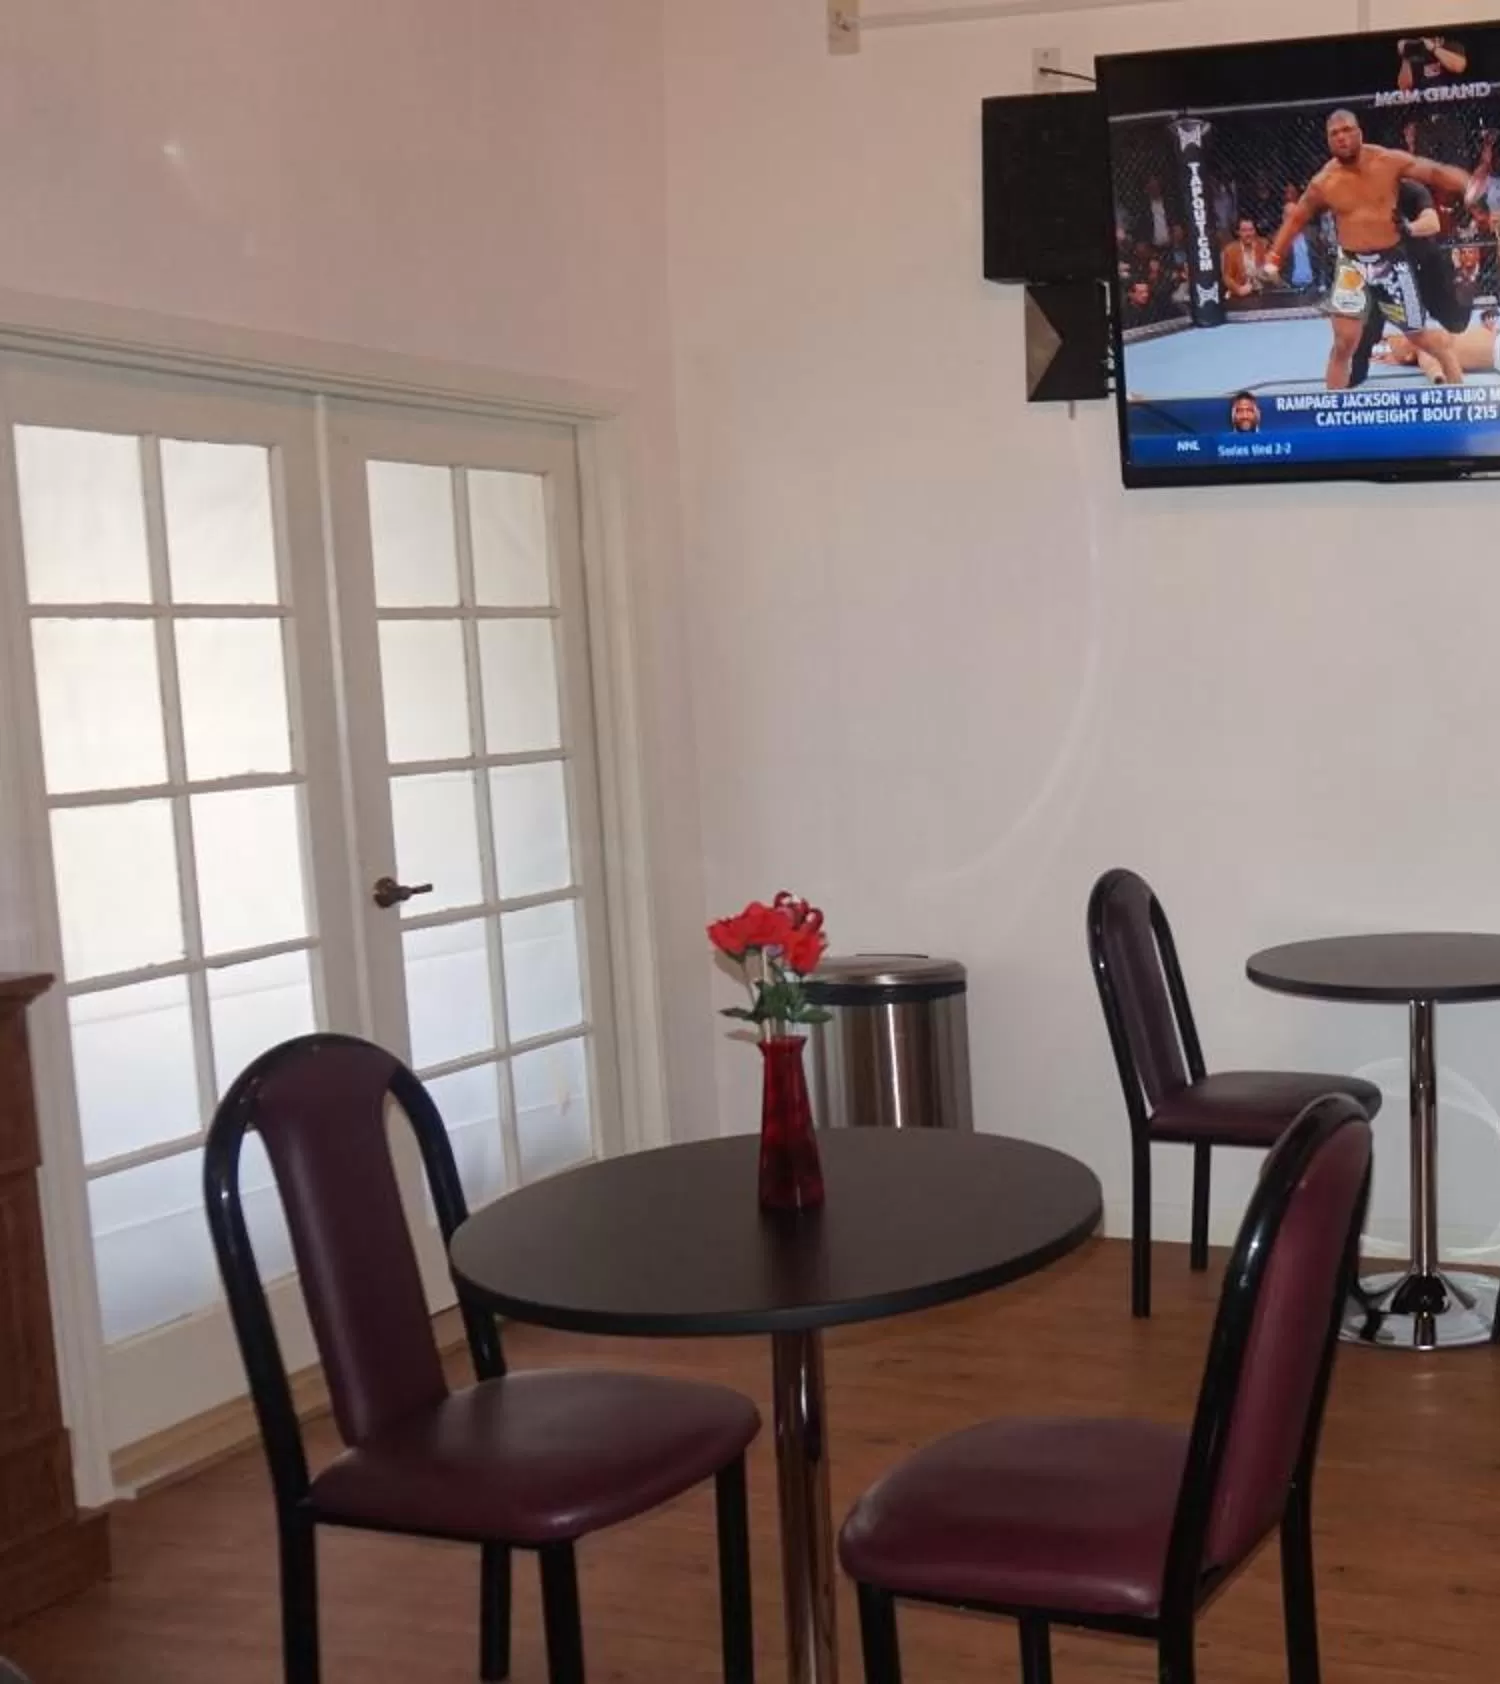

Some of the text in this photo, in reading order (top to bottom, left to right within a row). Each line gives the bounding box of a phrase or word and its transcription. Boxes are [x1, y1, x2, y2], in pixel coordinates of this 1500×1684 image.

[1375, 80, 1491, 108] MGM GRAND
[1276, 394, 1339, 412] RAMPAGE
[1342, 391, 1400, 409] JACKSON
[1420, 389, 1443, 405] #12
[1447, 387, 1487, 404] FABIO
[1316, 408, 1419, 427] CATCHWEIGHT
[1423, 405, 1465, 422] BOUT
[1467, 405, 1498, 422] (215
[1177, 440, 1200, 452] NHL
